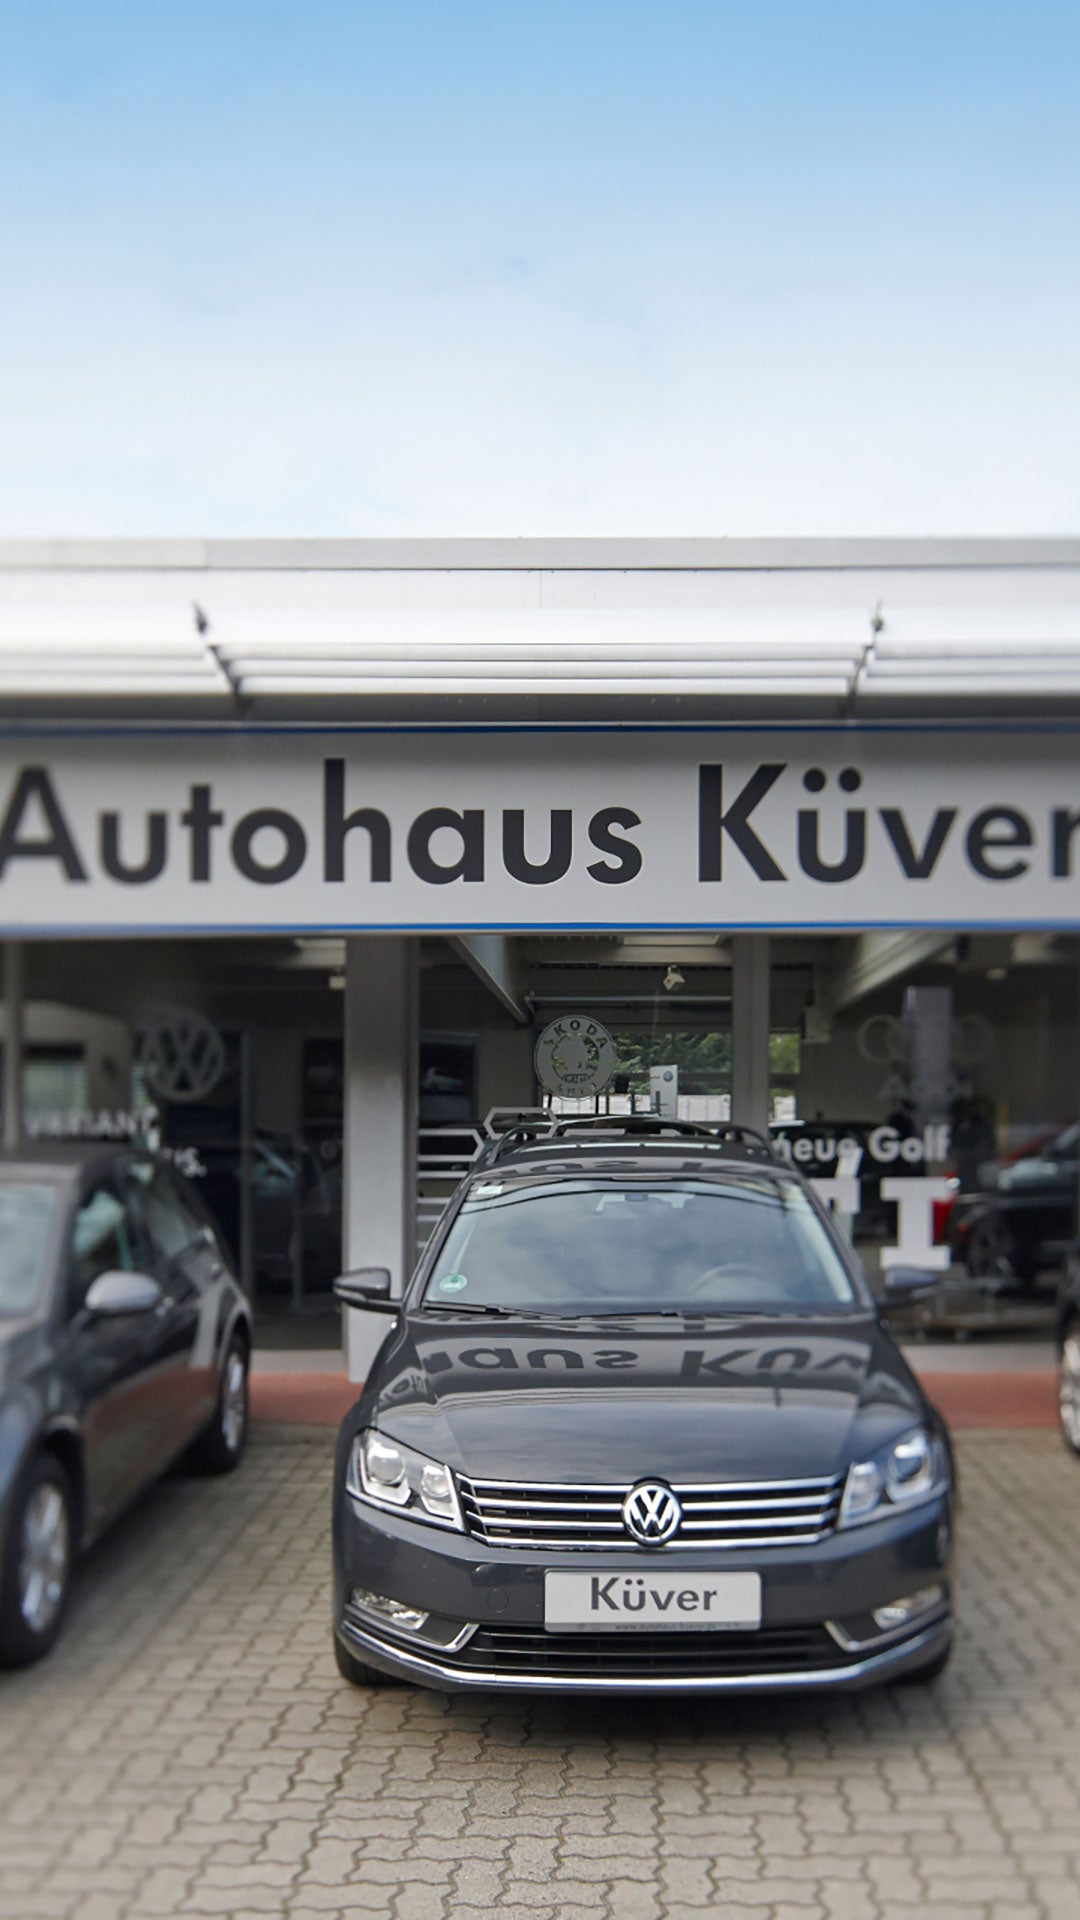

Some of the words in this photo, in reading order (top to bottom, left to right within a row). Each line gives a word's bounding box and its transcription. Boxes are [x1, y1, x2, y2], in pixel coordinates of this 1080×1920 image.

[0, 758, 643, 885] Autohaus
[698, 762, 1080, 883] Küver
[868, 1124, 951, 1163] Golf
[591, 1577, 718, 1612] Küver
